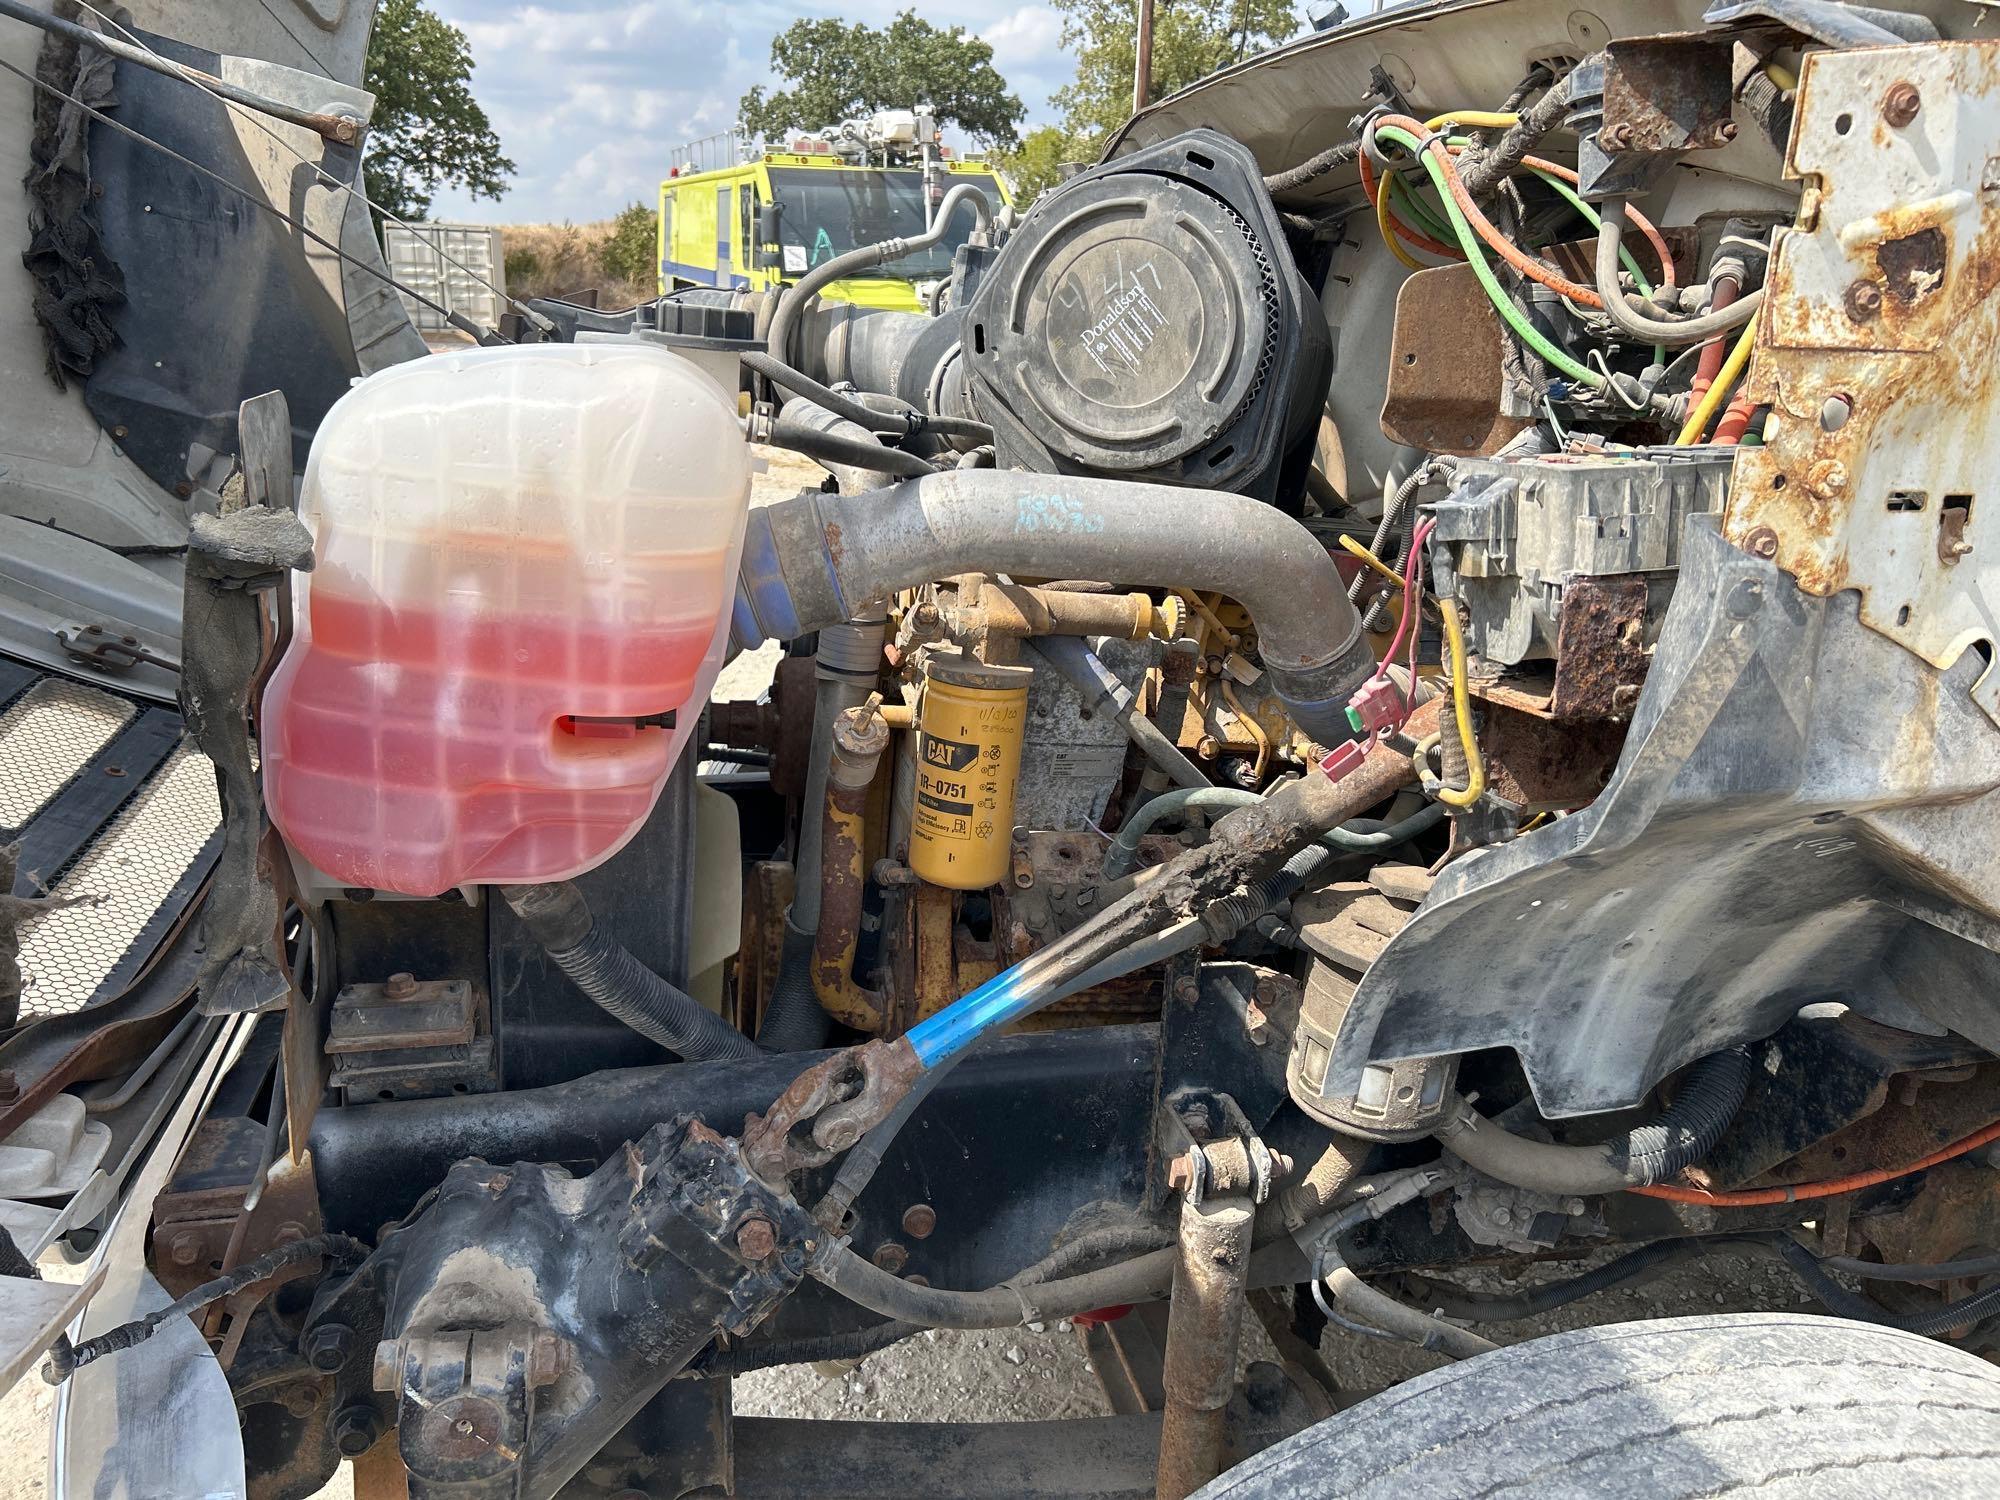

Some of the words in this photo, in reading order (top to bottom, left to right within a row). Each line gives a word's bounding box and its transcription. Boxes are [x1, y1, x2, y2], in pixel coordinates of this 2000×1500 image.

[1079, 284, 1145, 346] Donaldson
[927, 739, 956, 766] CAT
[920, 772, 967, 799] 1R-0751
